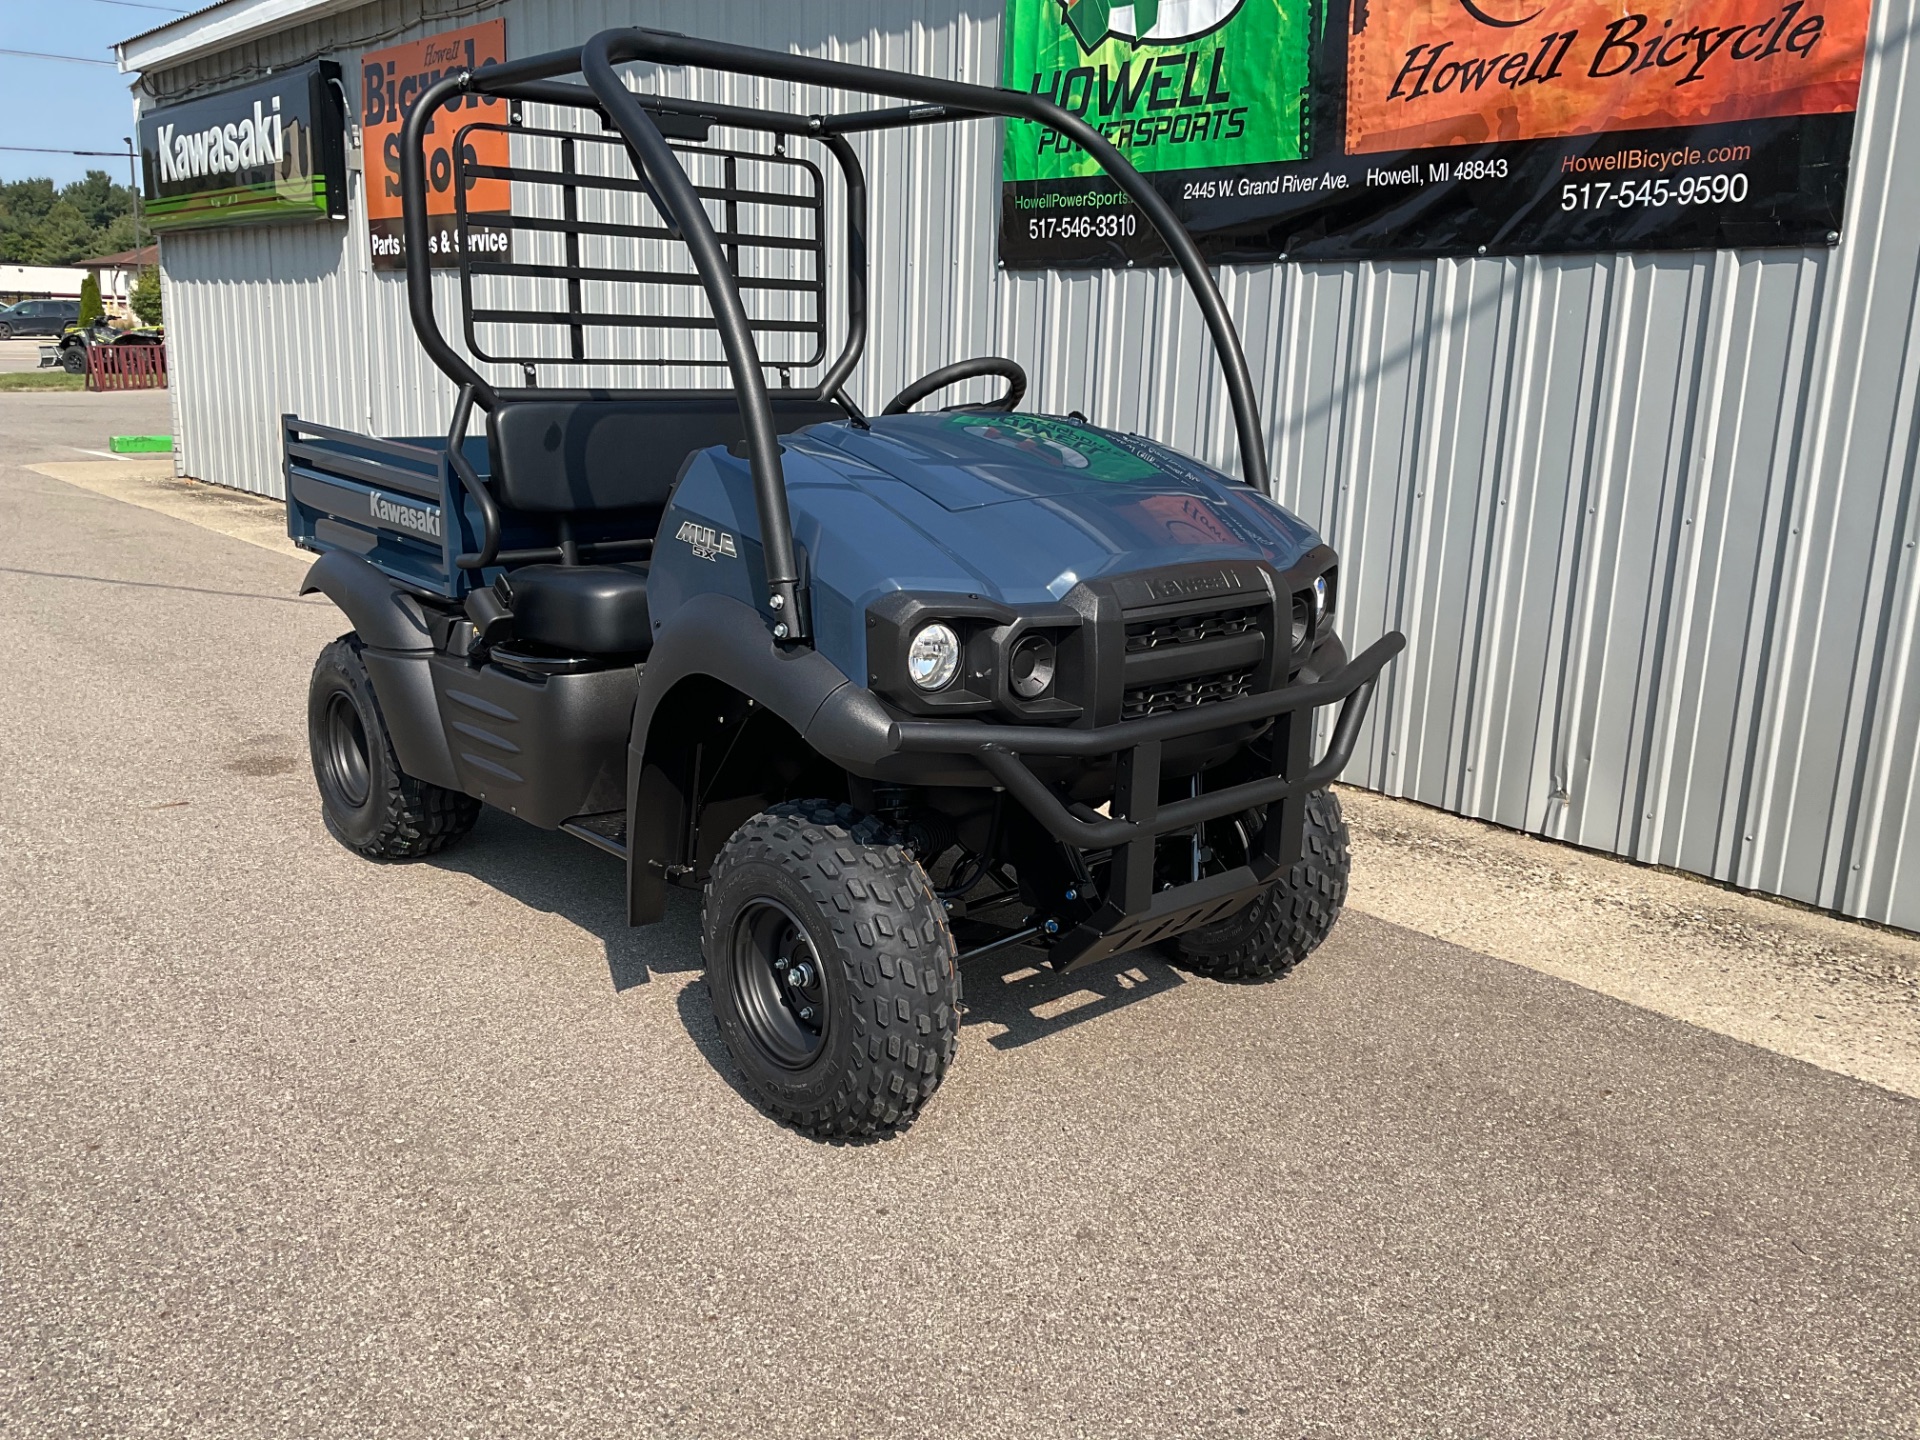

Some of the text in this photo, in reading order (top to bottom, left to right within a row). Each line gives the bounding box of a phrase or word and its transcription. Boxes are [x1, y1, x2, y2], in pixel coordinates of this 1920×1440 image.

[424, 40, 461, 67] Howell
[1386, 0, 1824, 102] Howell Bicycle
[1024, 47, 1231, 124] HOWELL
[158, 95, 284, 184] Kawasaki
[1561, 145, 1752, 173] HowellBicycle.com
[1183, 159, 1509, 200] 2445 W. Grand River Ave. Howell, MI 48843
[1561, 173, 1749, 211] 517-545-9590
[371, 233, 400, 256] Parts
[440, 229, 451, 254] &
[1029, 214, 1136, 239] 517-546-3310
[369, 491, 441, 537] Kawasaki
[675, 521, 738, 558] MULE
[692, 545, 717, 562] SX
[1143, 569, 1241, 600] Kawasaki
